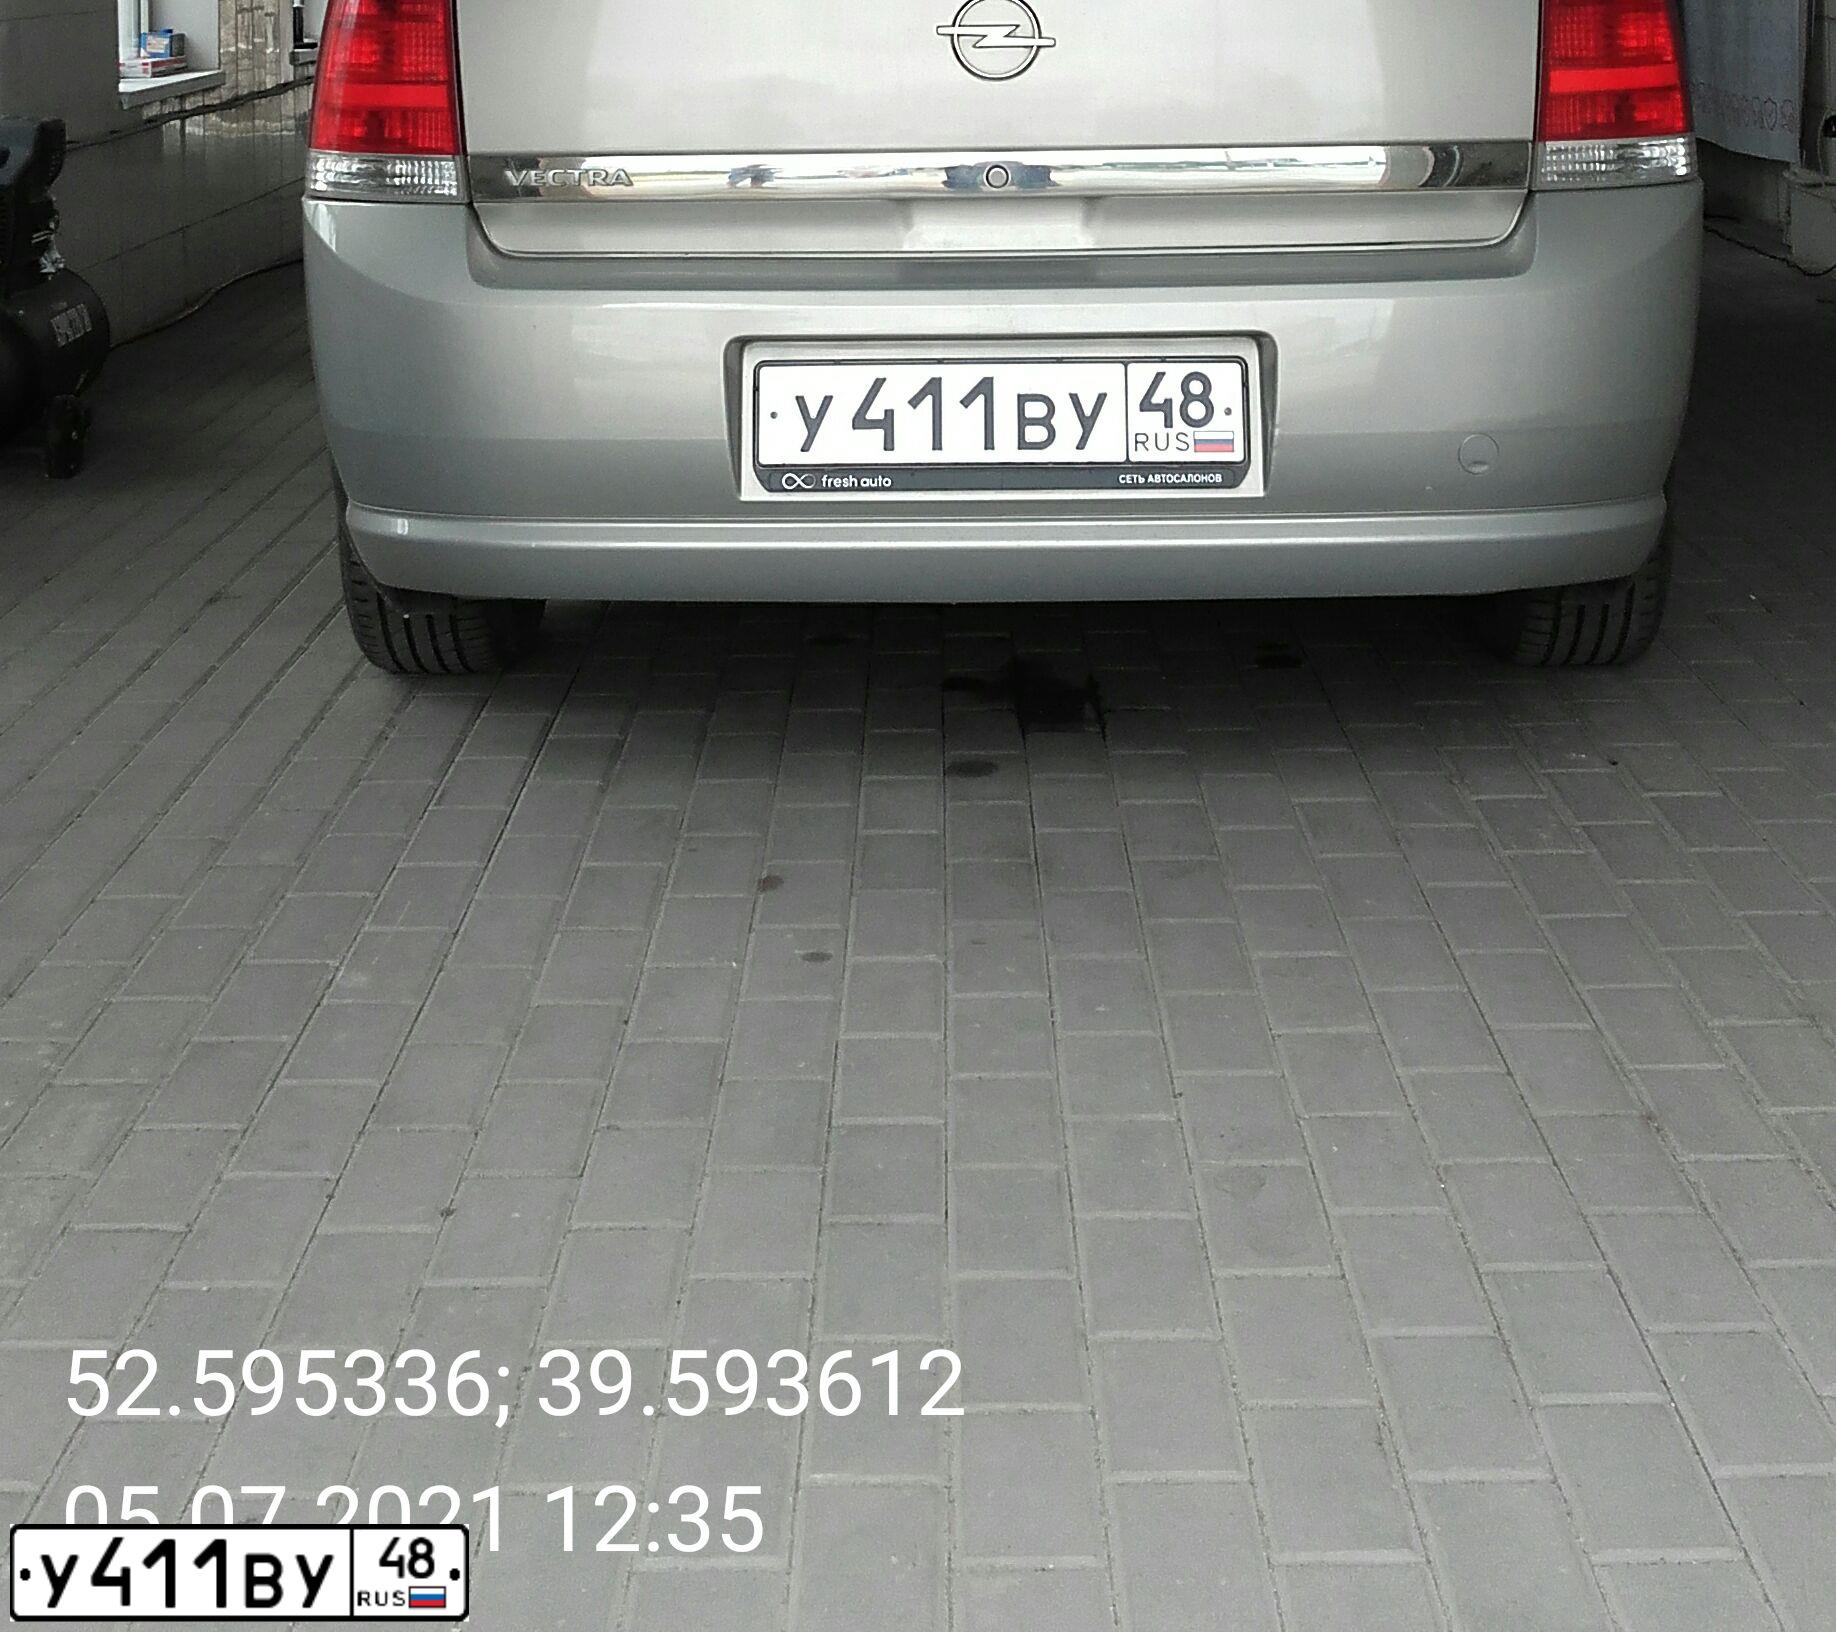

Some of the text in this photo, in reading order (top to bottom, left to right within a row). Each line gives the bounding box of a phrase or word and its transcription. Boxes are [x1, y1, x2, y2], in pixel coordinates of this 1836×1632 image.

[505, 168, 634, 187] VECTRA
[1139, 371, 1215, 429] 48
[1134, 432, 1190, 452] RUS
[821, 474, 892, 488] fresh auto
[1118, 473, 1223, 484] СЕТЬ АВТОСАЛОНОВ
